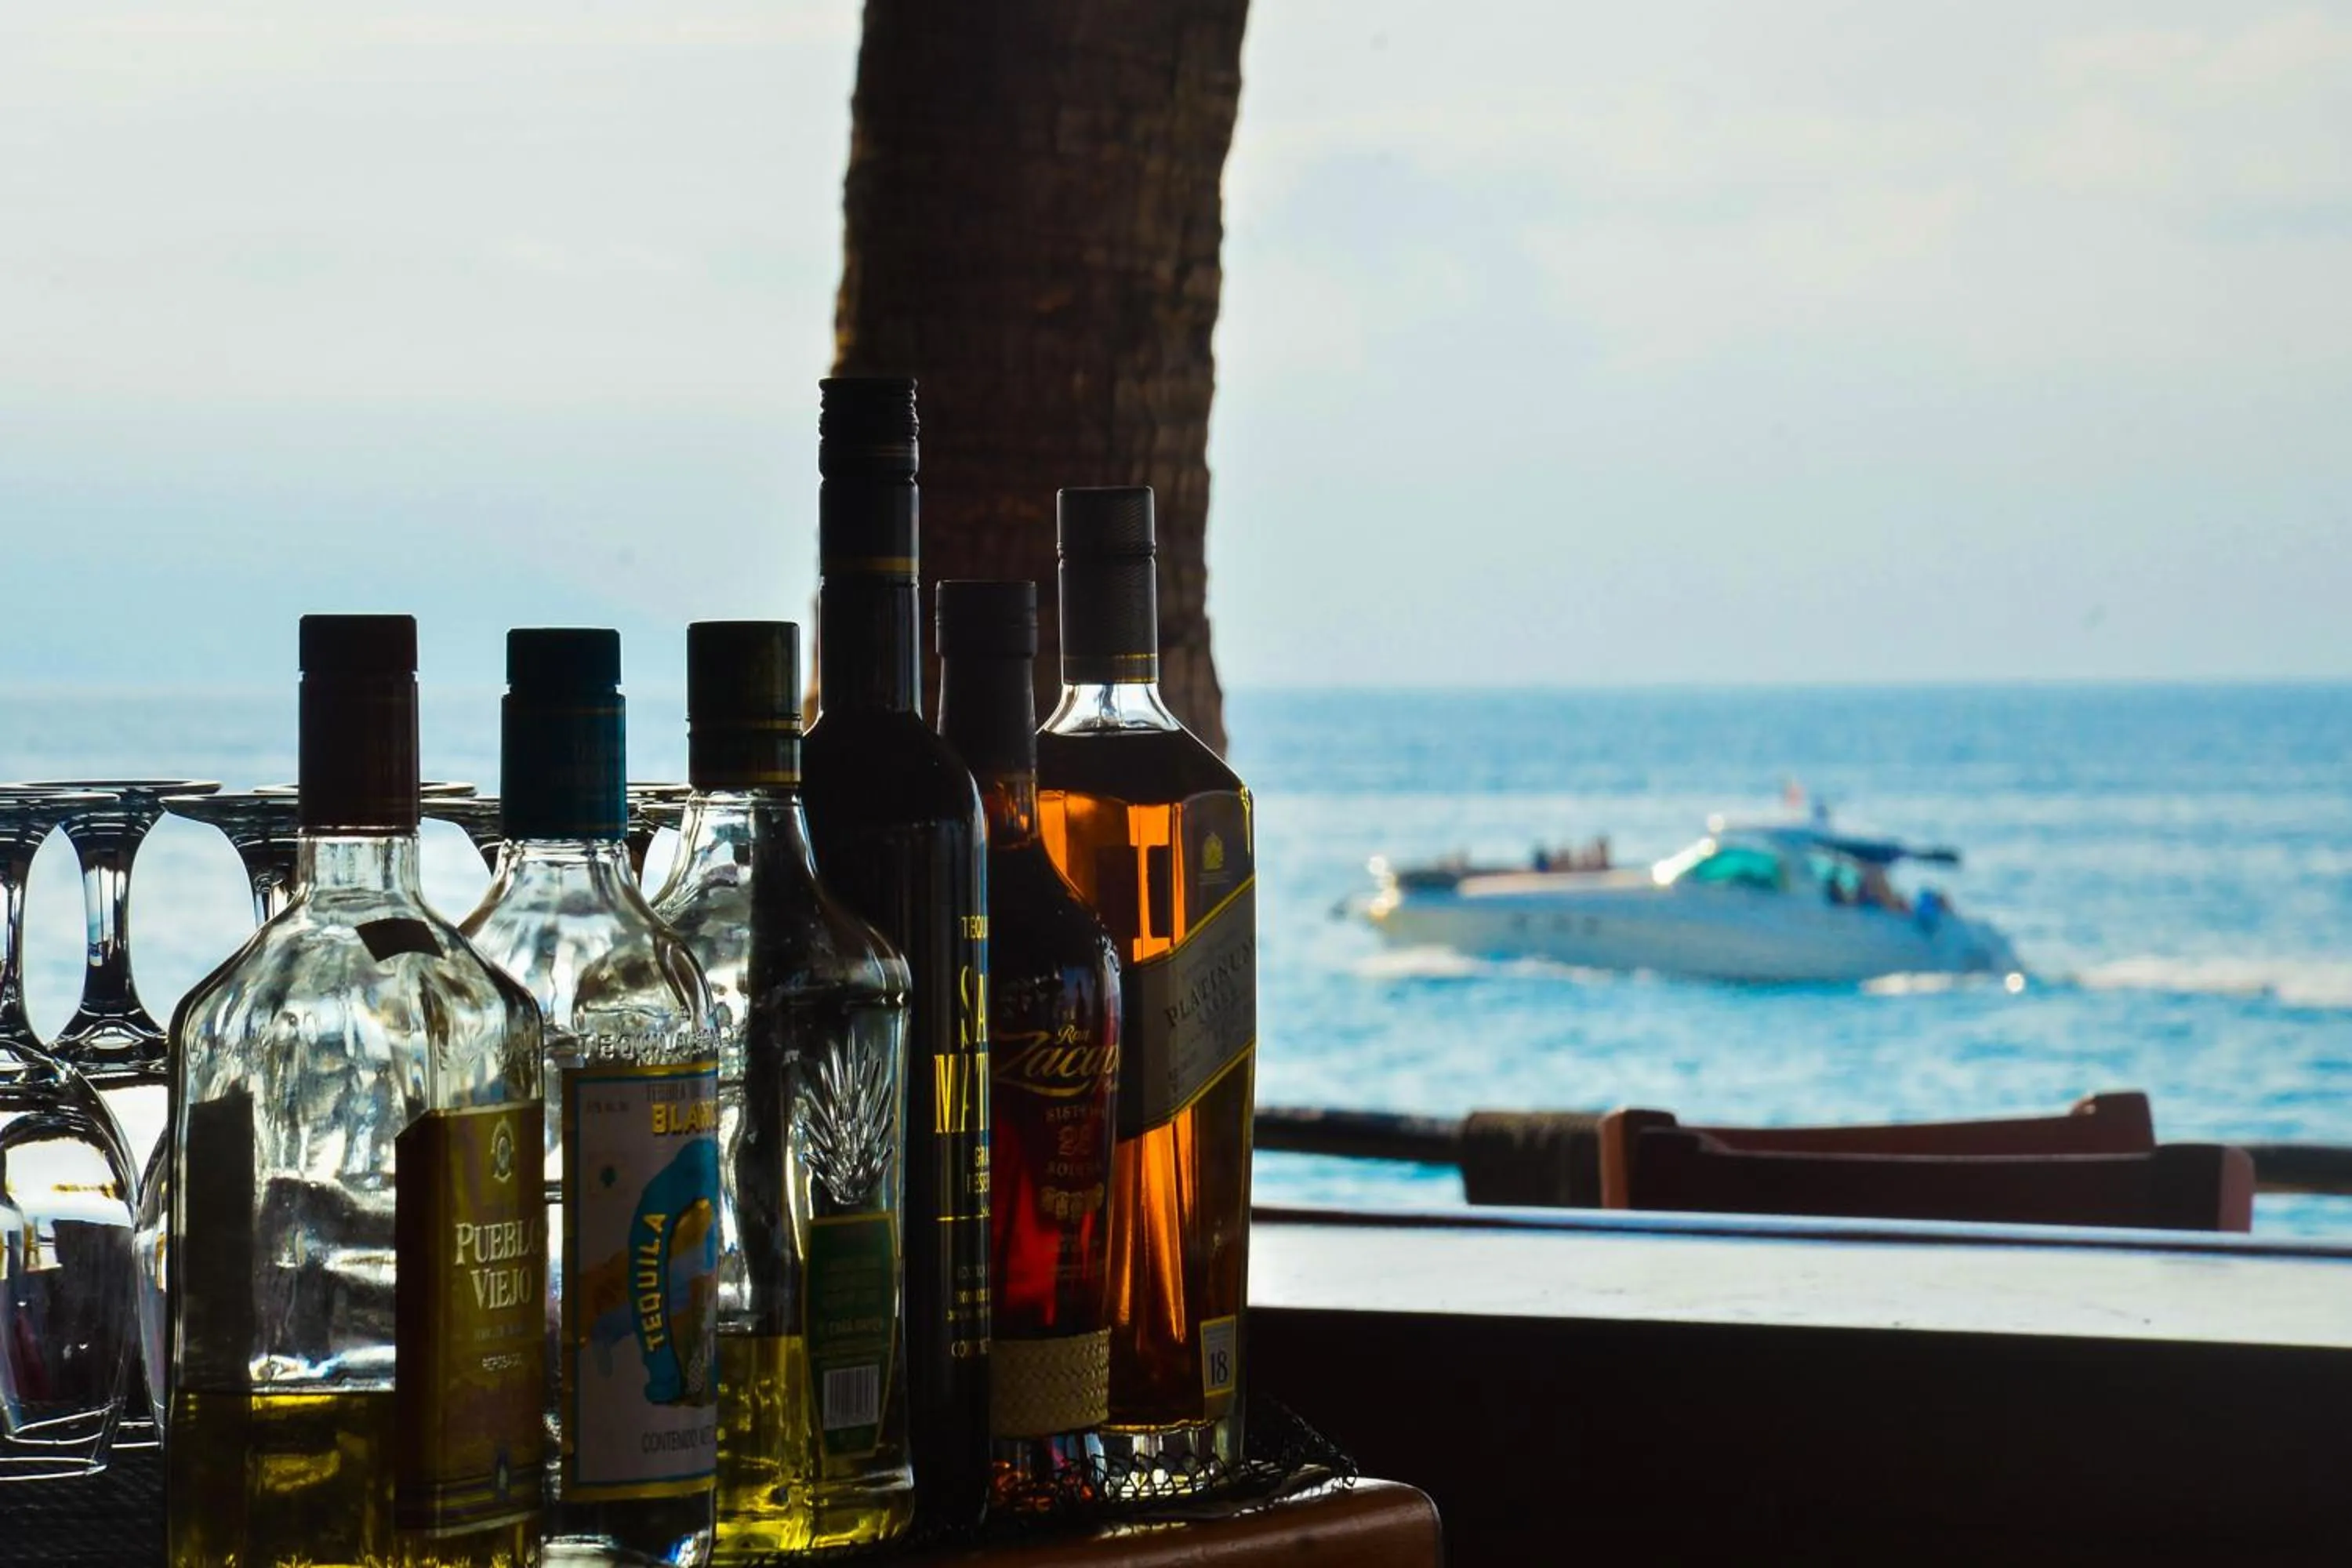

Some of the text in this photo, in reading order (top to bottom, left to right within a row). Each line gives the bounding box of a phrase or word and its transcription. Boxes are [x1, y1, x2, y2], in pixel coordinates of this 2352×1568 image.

[470, 1267, 533, 1310] VIEJO
[636, 1214, 666, 1352] TEQUILA
[1210, 1351, 1228, 1386] 18
